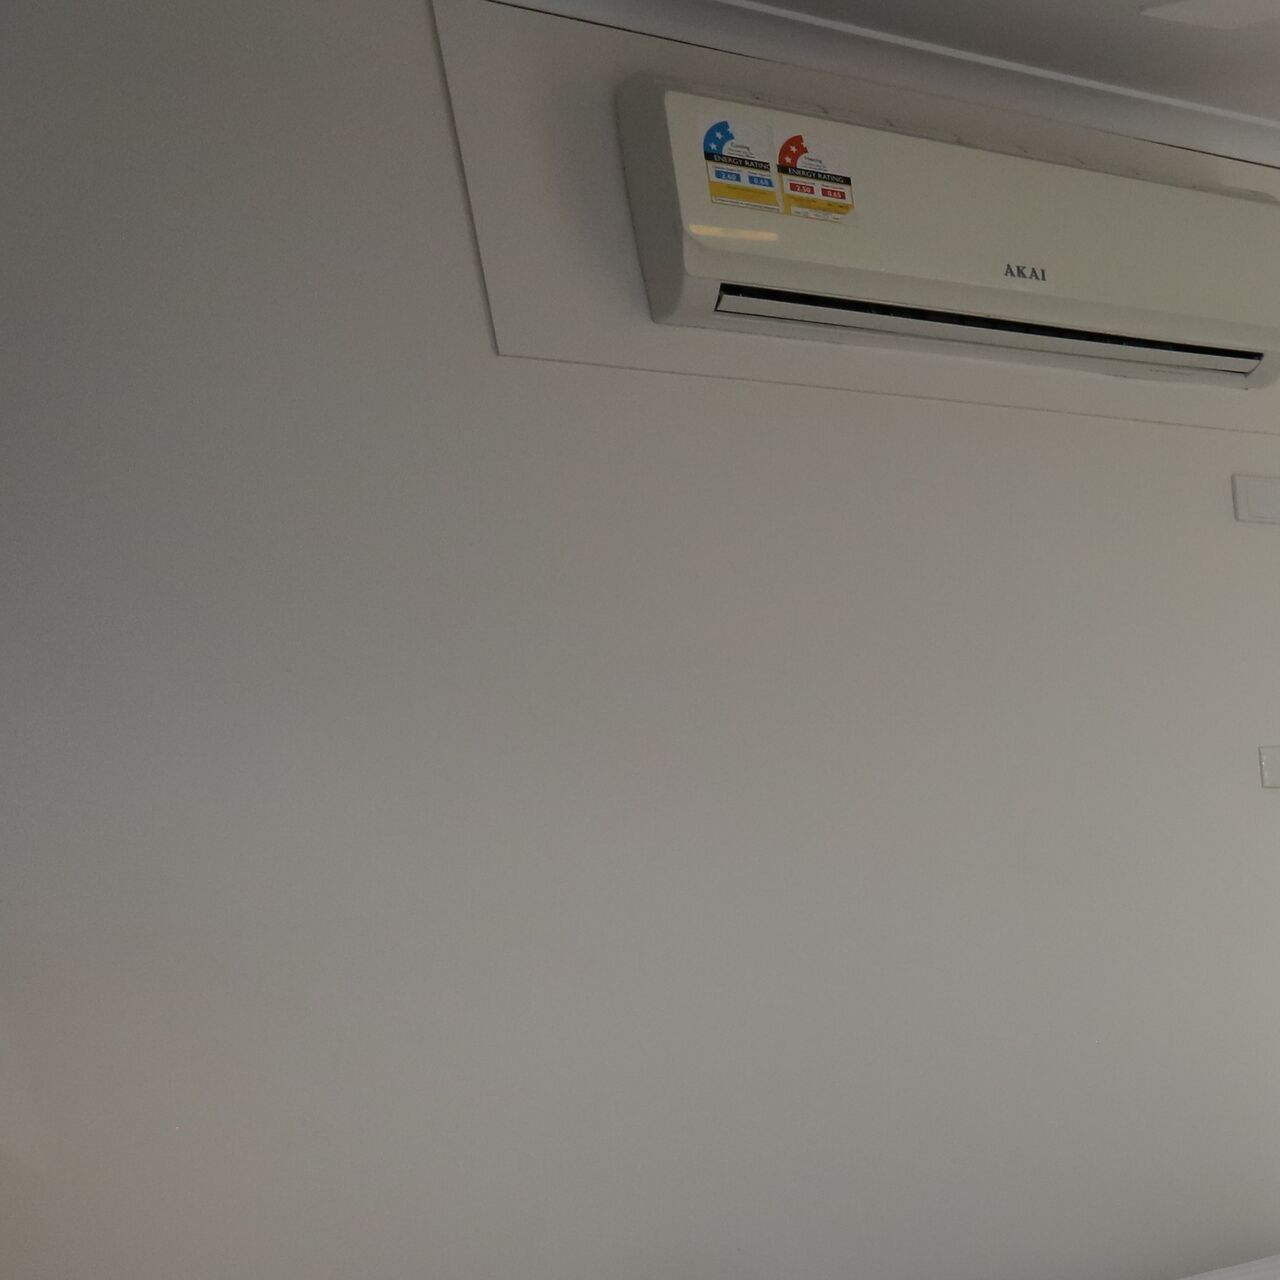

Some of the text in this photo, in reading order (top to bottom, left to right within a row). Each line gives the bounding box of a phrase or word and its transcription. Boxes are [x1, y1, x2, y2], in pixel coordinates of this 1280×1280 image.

[788, 168, 817, 179] ENERGY
[818, 172, 844, 183] RATING
[1004, 263, 1047, 281] AKAI
